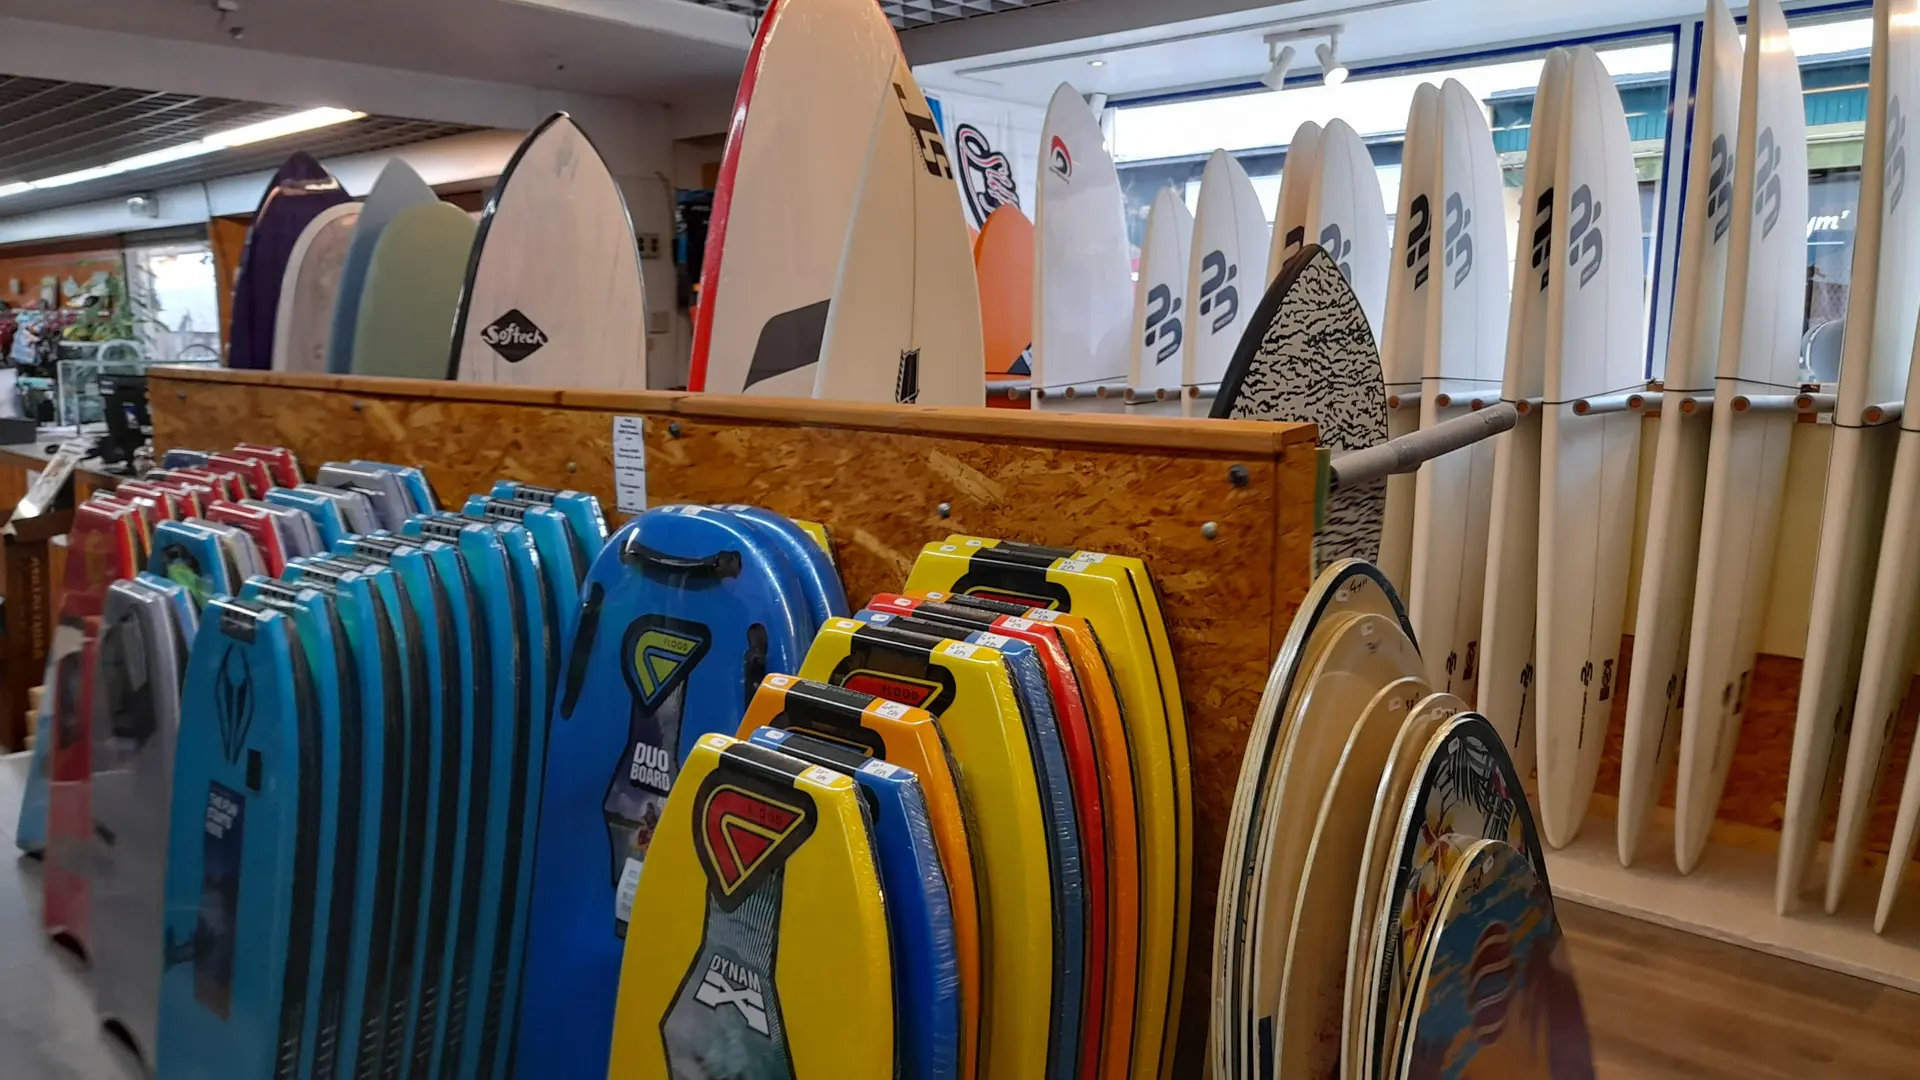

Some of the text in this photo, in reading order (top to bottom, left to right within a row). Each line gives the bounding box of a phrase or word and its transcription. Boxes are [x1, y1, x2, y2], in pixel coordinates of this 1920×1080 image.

[481, 322, 546, 345] Softech
[881, 683, 919, 700] FLOOD
[633, 742, 669, 773] DUO
[630, 763, 670, 792] BOARD
[710, 954, 761, 993] DYNAM
